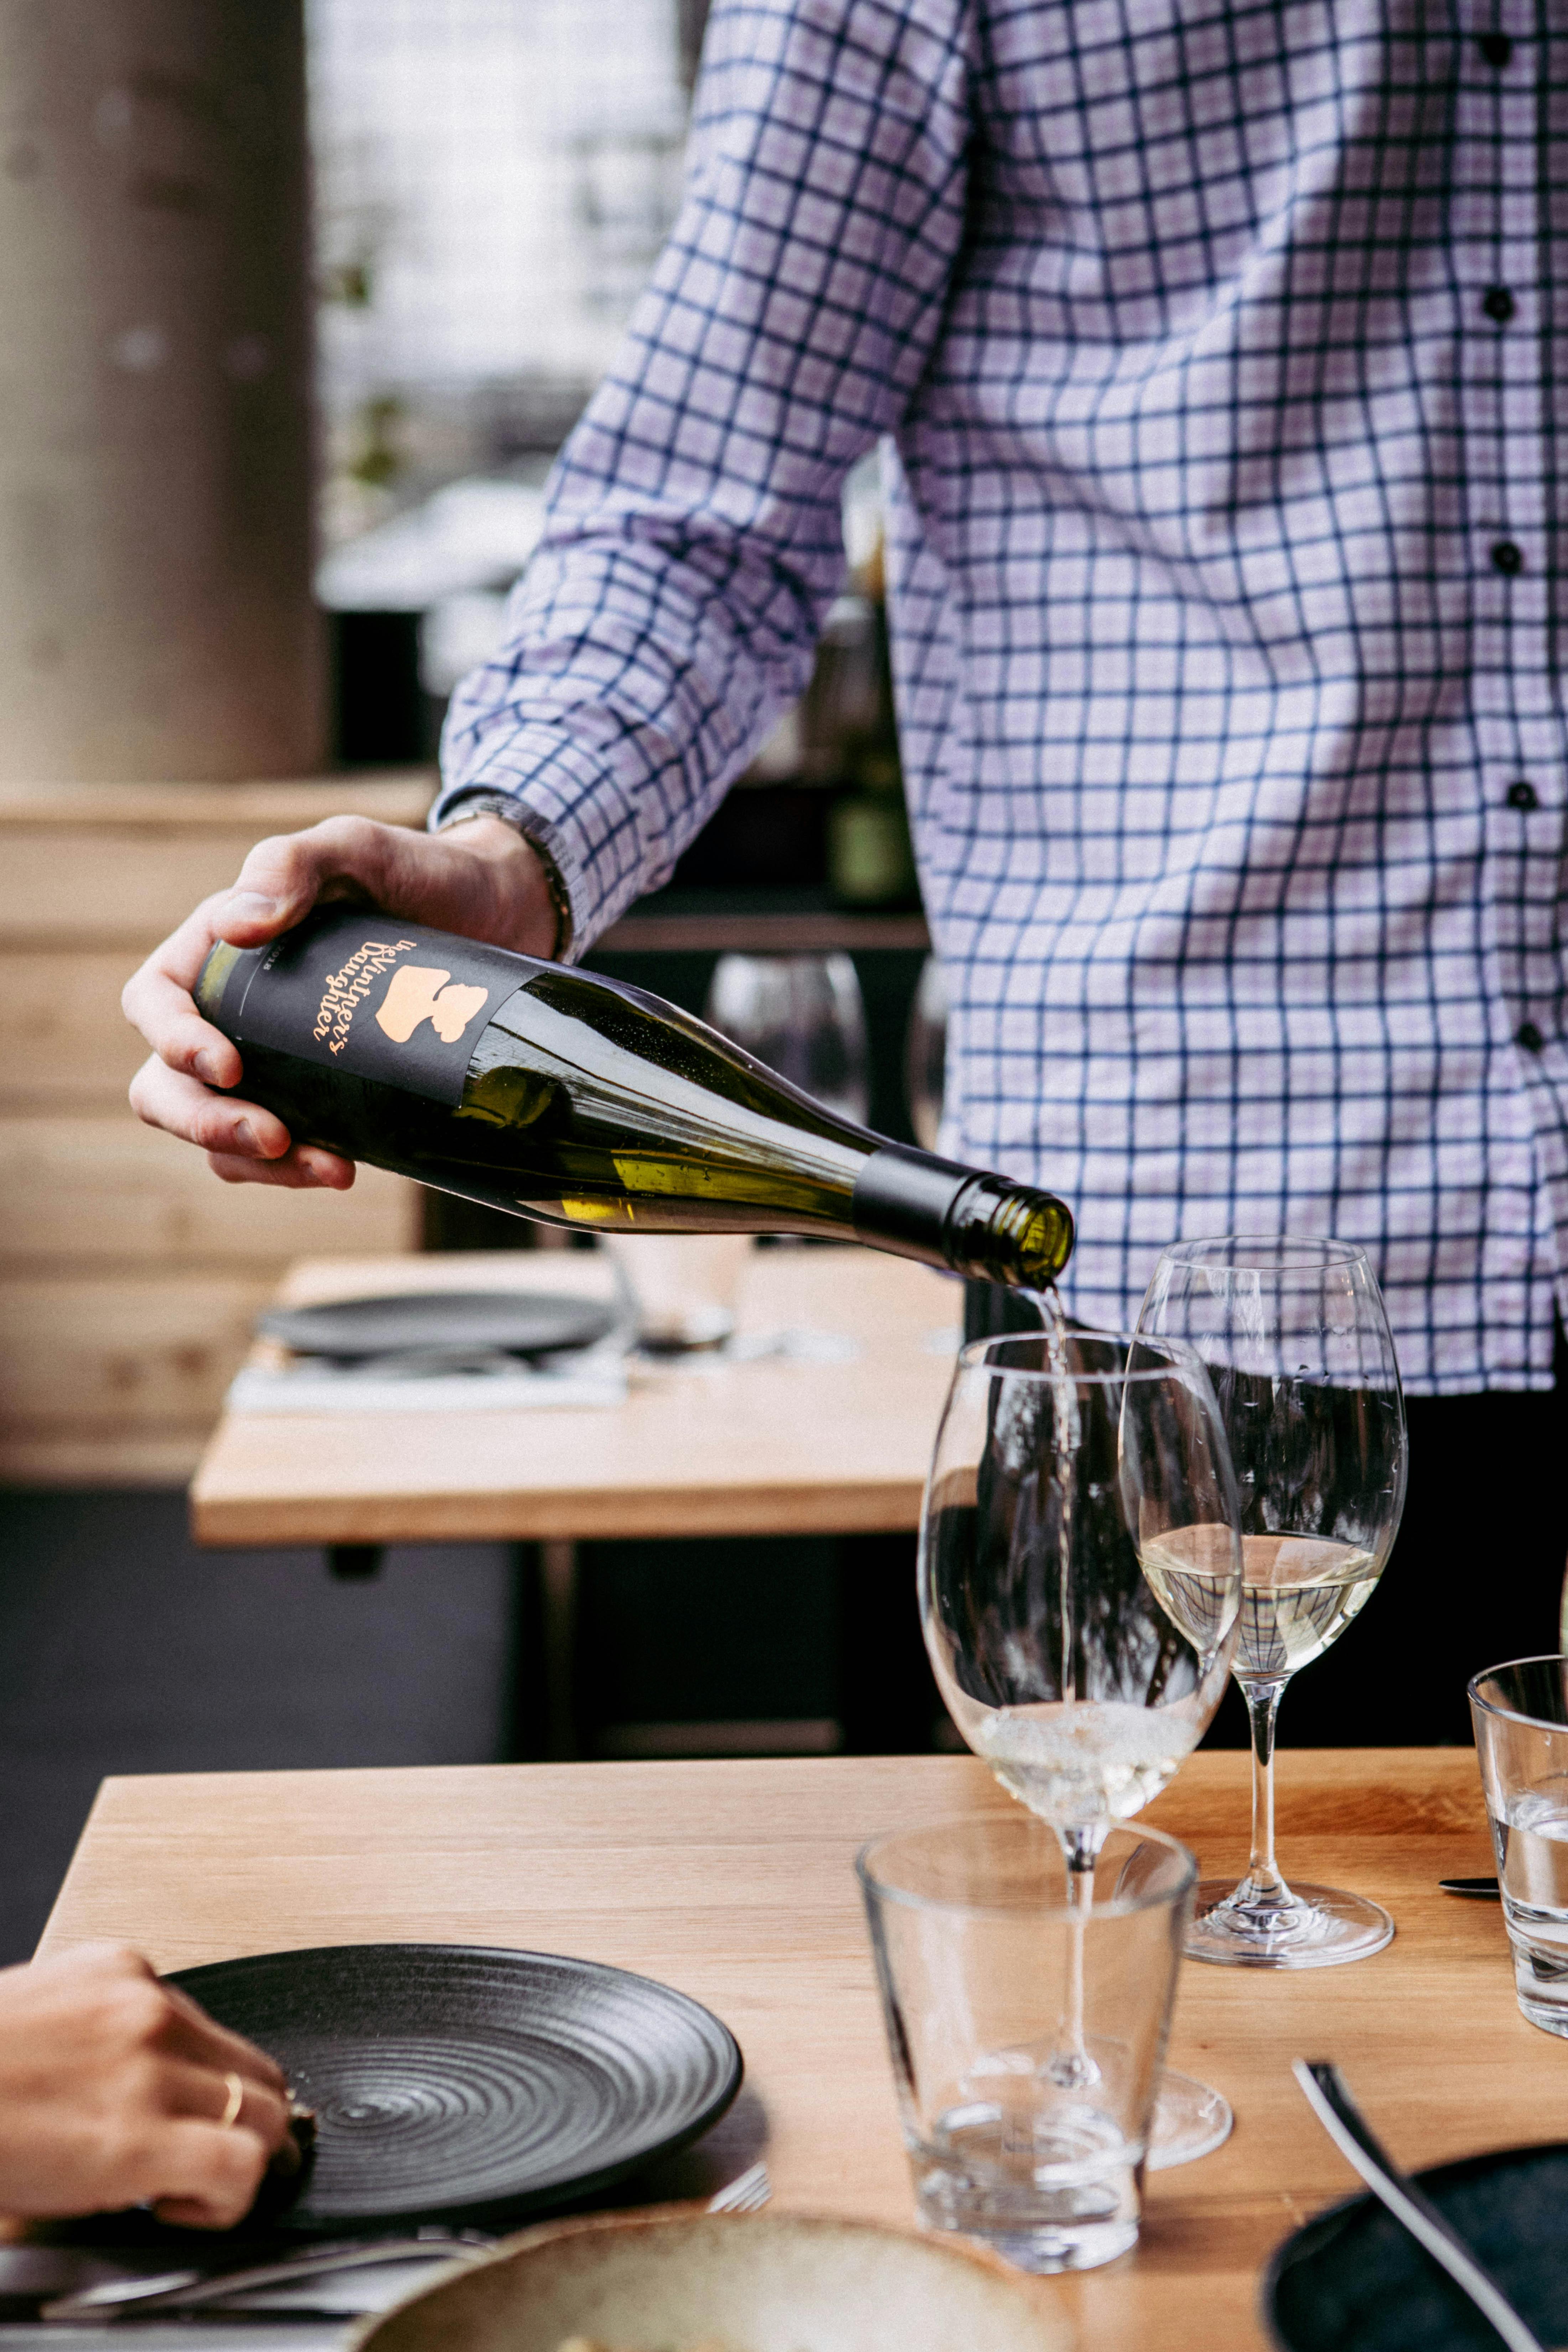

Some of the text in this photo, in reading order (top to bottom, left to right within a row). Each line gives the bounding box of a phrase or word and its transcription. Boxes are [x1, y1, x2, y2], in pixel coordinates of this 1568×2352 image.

[264, 945, 285, 970] 2018
[314, 942, 390, 1041] Daughter
[329, 940, 417, 1056] the Vintner's
